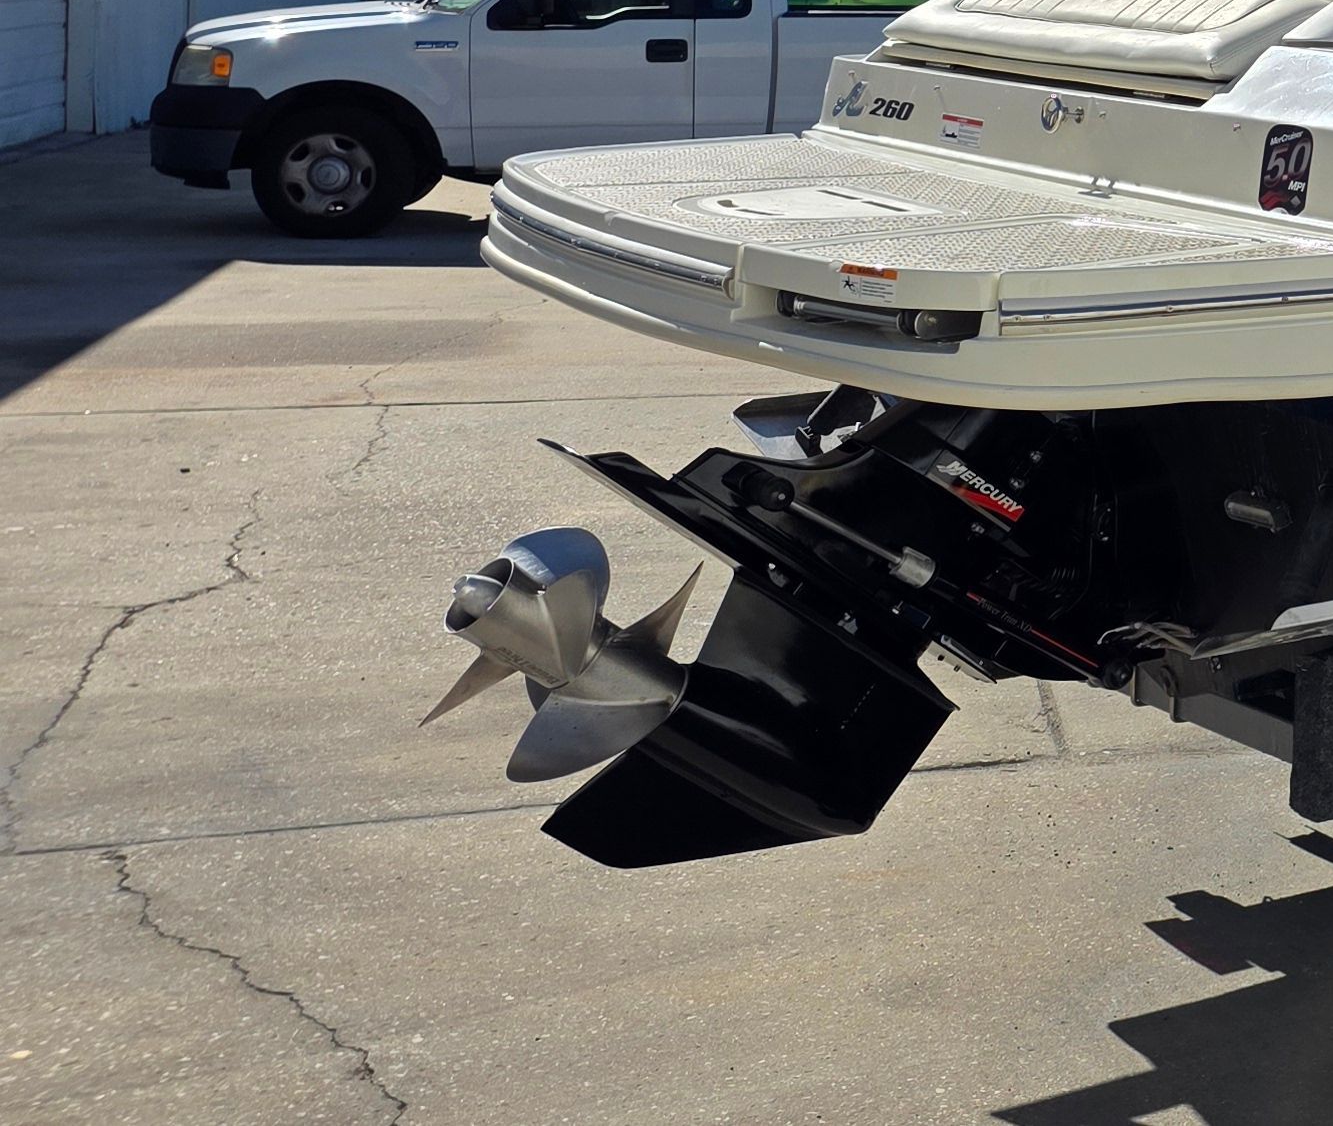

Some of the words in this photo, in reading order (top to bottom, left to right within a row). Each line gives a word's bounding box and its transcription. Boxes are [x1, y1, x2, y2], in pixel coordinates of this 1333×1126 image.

[869, 97, 915, 121] 260
[1269, 130, 1304, 146] MerCruiser
[1263, 137, 1312, 188] 5.0
[1287, 180, 1306, 192] MPI
[936, 460, 1023, 513] MERCURY
